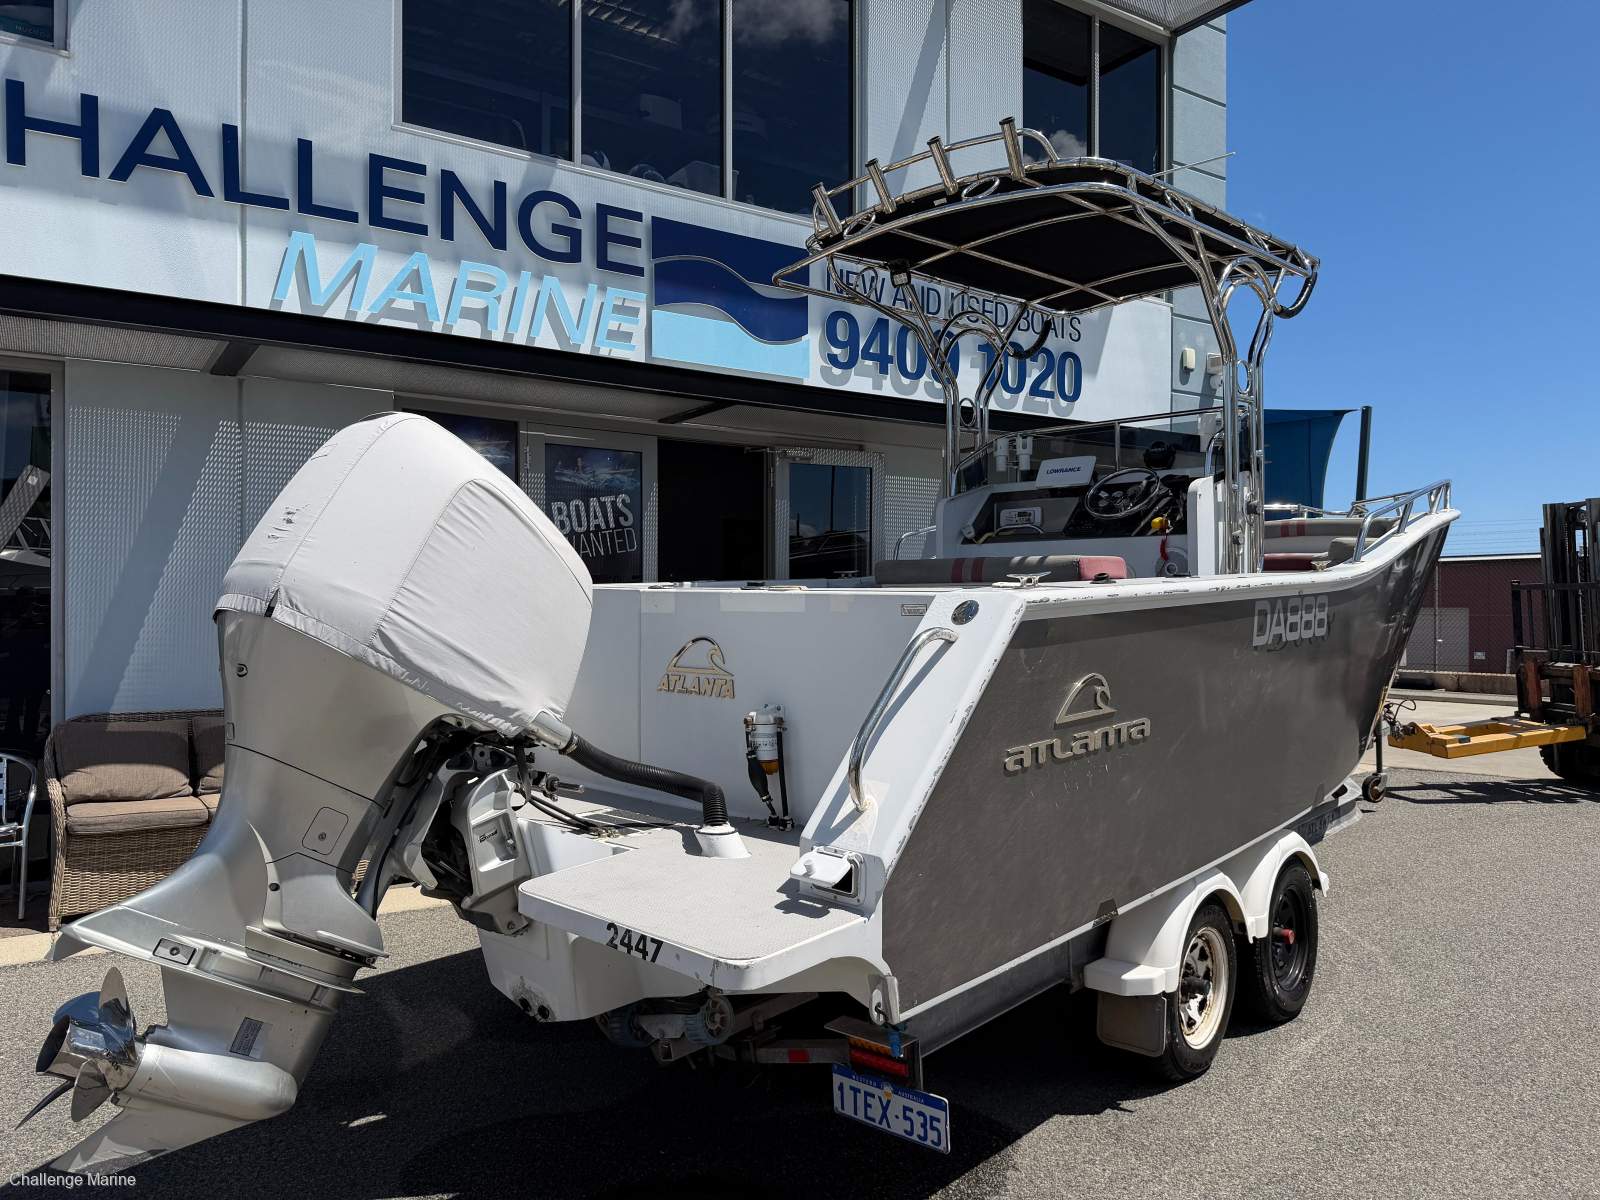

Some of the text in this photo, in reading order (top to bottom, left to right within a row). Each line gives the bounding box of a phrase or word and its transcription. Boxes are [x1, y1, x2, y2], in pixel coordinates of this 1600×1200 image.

[273, 231, 646, 351] MARINE
[826, 268, 1082, 343] NEW AND USED BOATS
[977, 341, 1083, 402] 1020
[1046, 465, 1081, 475] LOWRANCE
[551, 493, 634, 535] BOATS
[1253, 594, 1328, 646] DA888
[656, 673, 735, 699] ATLANTA
[606, 922, 663, 964] 2447
